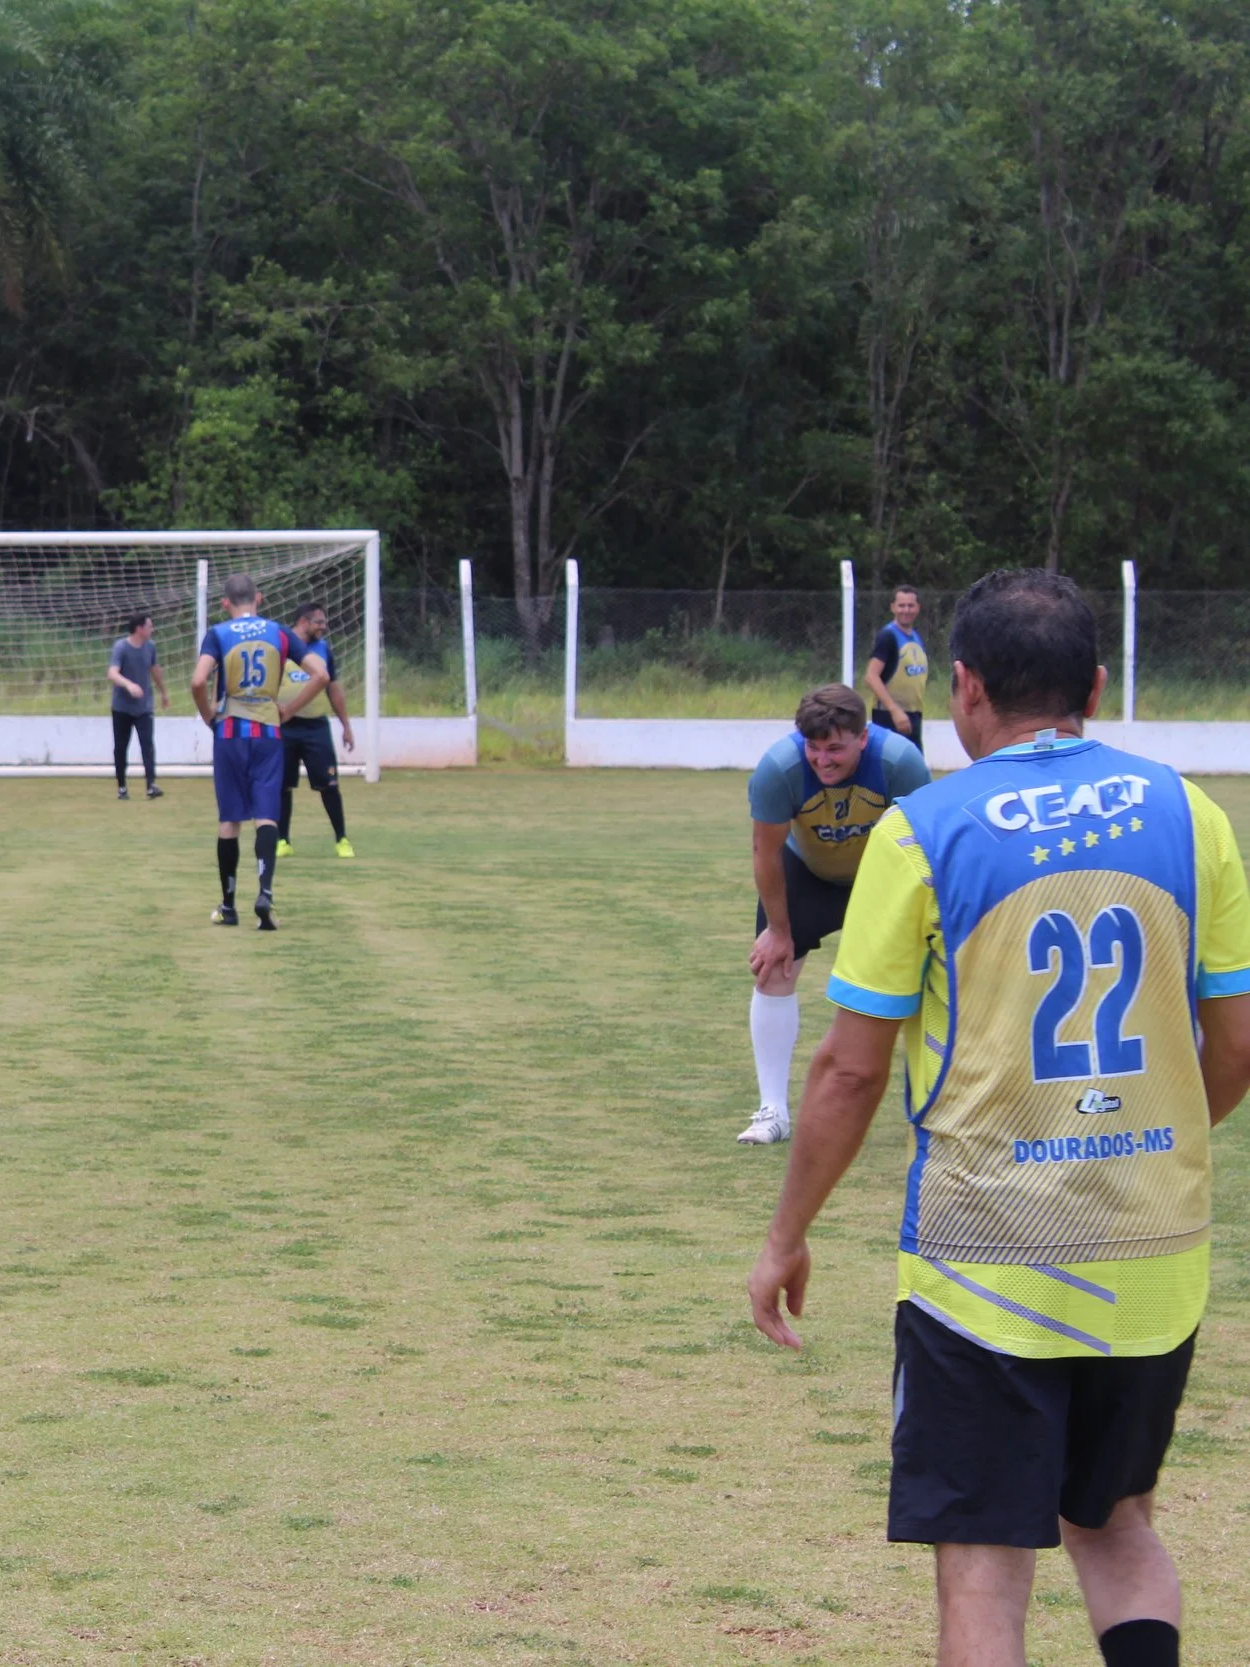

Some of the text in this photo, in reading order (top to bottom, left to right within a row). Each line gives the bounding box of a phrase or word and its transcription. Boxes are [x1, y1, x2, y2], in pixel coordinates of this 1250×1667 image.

[239, 648, 266, 688] 15
[985, 774, 1150, 833] CEART
[1026, 904, 1146, 1084] 22
[1014, 1126, 1174, 1164] DOURADOS-MS
